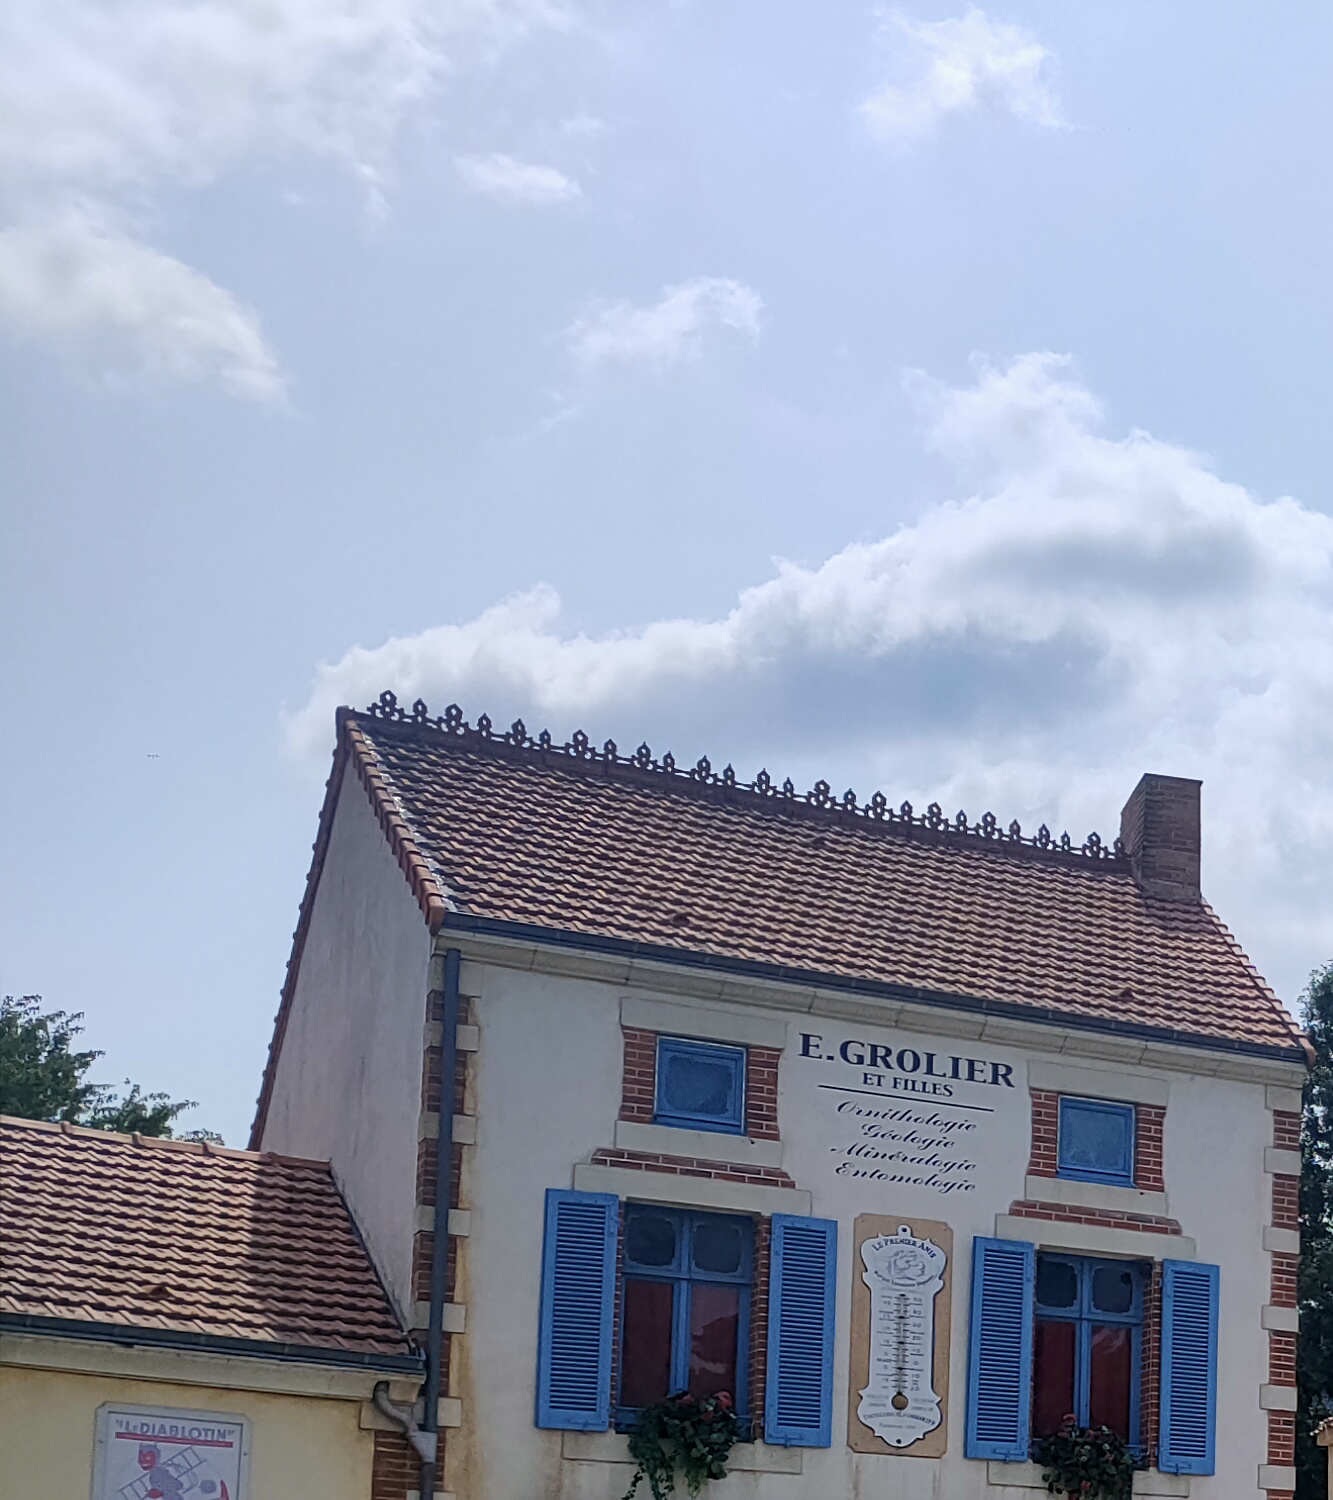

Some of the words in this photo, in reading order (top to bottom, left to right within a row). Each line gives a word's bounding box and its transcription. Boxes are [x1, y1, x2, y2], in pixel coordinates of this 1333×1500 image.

[863, 1072, 886, 1087] ET
[892, 1078, 953, 1097] FILLES
[837, 1100, 977, 1133] Ornithologie
[861, 1123, 955, 1150] Géologie
[830, 1142, 976, 1174] Minéralogie
[835, 1162, 976, 1194] Entomologie
